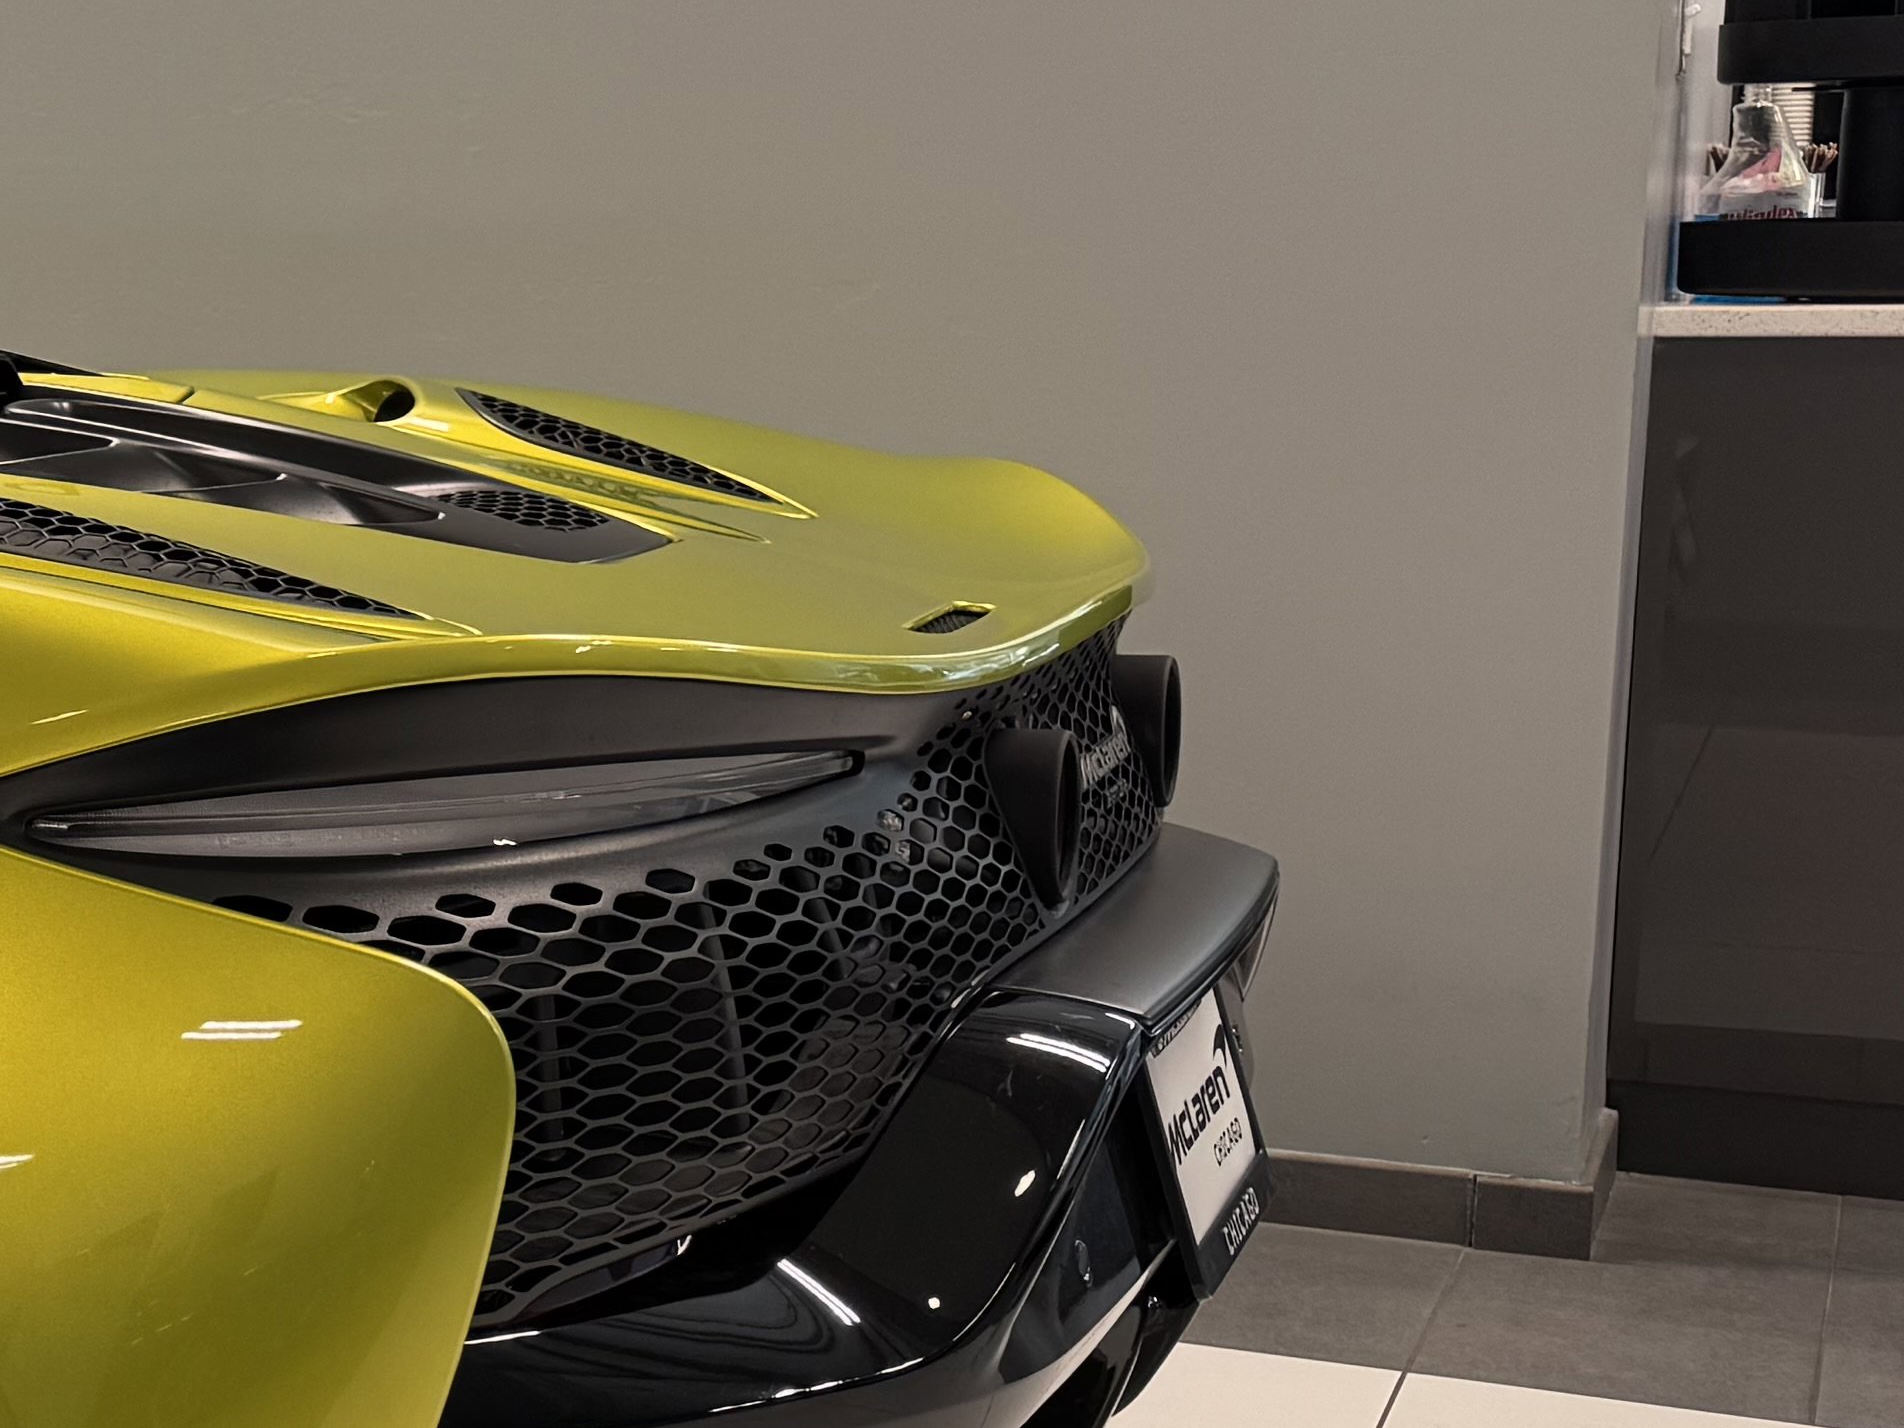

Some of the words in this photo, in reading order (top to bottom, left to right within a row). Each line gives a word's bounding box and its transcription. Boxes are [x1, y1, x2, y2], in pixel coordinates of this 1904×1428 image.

[1167, 1065, 1231, 1166] McLaren
[1213, 1117, 1242, 1167] CHICAGO
[1222, 1187, 1260, 1256] CHICAGO
